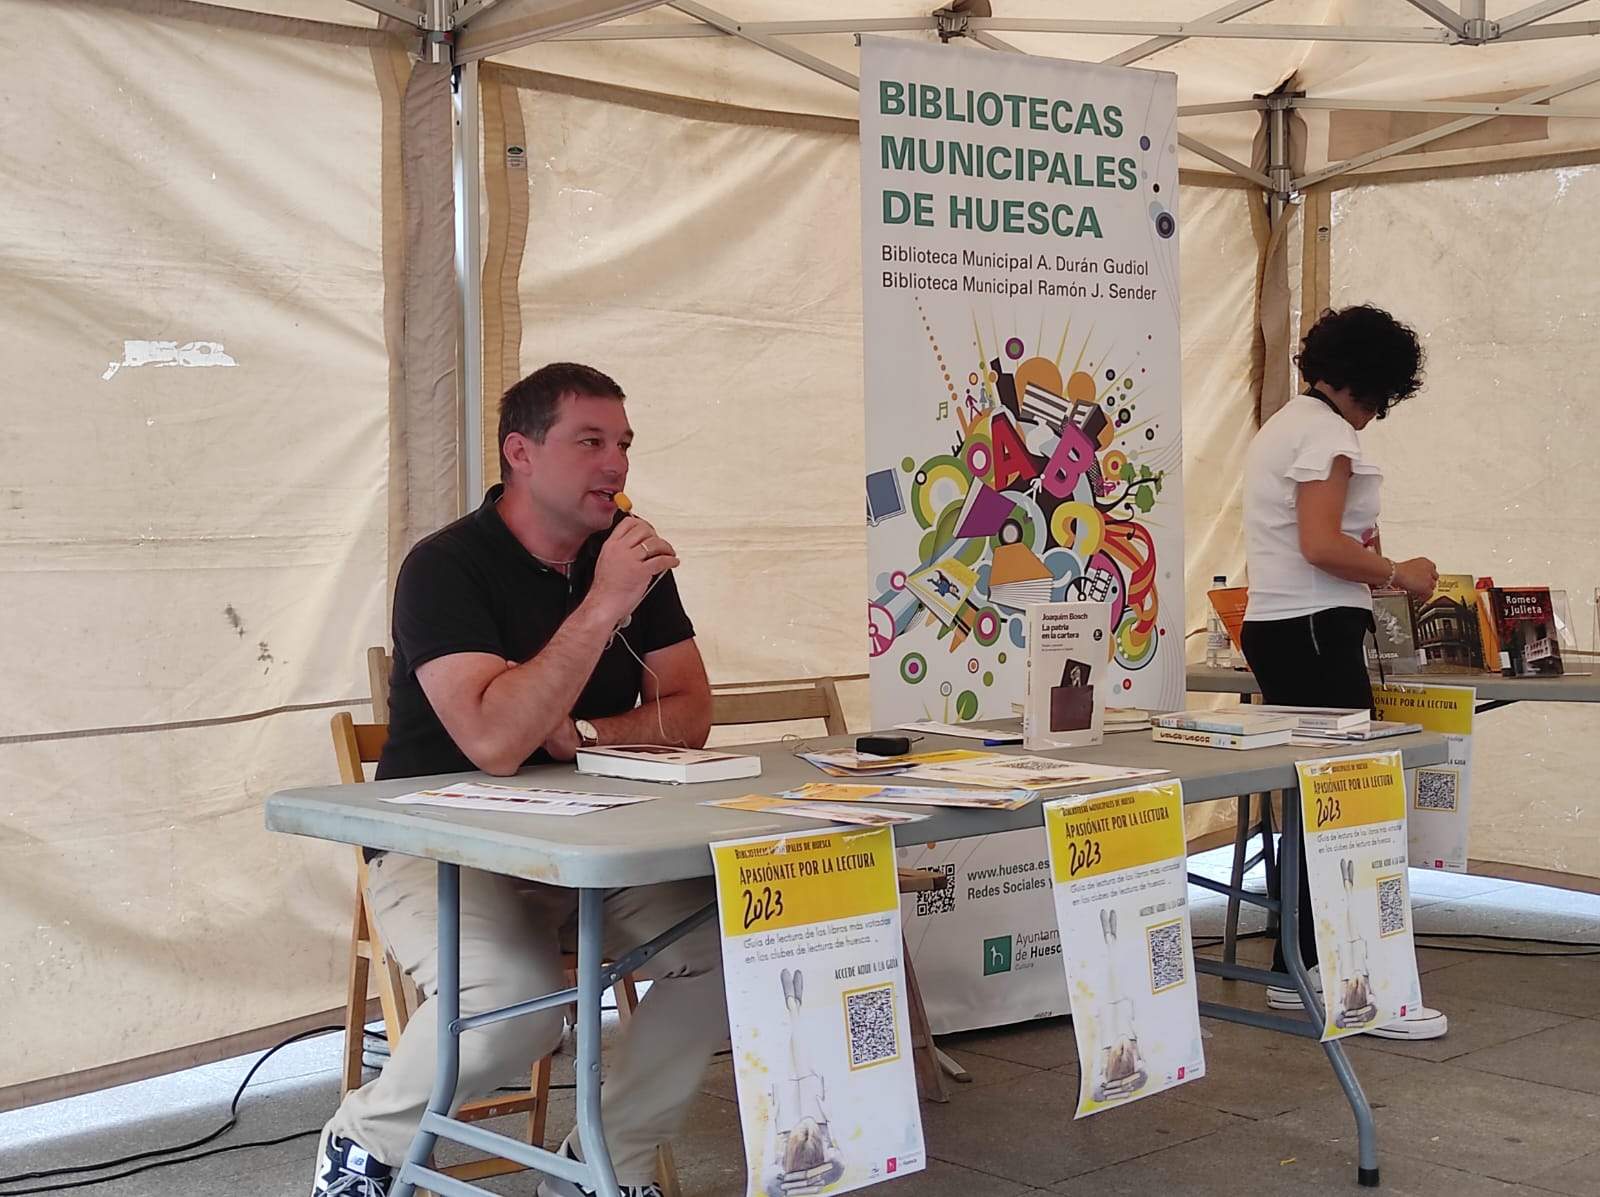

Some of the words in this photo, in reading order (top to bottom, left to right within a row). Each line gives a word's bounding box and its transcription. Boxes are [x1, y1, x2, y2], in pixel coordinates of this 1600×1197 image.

[879, 80, 1124, 139] BIBLIOTECAS
[880, 135, 1138, 191] MUNICIPALES
[881, 190, 935, 227] DE
[949, 195, 1104, 239] HUESCA
[881, 244, 958, 265] Biblioteca
[962, 250, 1033, 273] Municipal
[1036, 256, 1052, 271] A.
[1056, 256, 1098, 274] Durán
[1103, 258, 1149, 276] Gudiol
[881, 272, 958, 292] Biblioteca
[962, 277, 1033, 299] Municipal
[1037, 280, 1087, 298] Ramón
[1090, 284, 1104, 299] J.
[1108, 284, 1157, 300] Sender
[1503, 606, 1509, 616] y
[1509, 604, 1543, 617] Julieta
[1505, 595, 1537, 604] Romeo
[1050, 623, 1069, 632] patria
[1069, 612, 1088, 620] Bosch
[1427, 699, 1458, 710] LECTURA
[1065, 818, 1109, 840] APASIÓNATE
[1112, 814, 1128, 830] POR
[1130, 812, 1139, 826] LA
[1139, 806, 1170, 824] LECTURA
[1316, 796, 1341, 828] 2023
[739, 861, 797, 886] APASIÓNATE
[799, 861, 819, 878] POR
[822, 859, 834, 873] LA
[836, 852, 876, 872] LECTURA
[967, 859, 1050, 881] www.huesca.es
[1068, 839, 1101, 877] 2023
[967, 885, 1000, 900] Redes
[1002, 878, 1046, 894] Sociales
[742, 886, 784, 930] 2023
[1016, 928, 1060, 947] Ayuntam
[1015, 949, 1028, 962] de
[1030, 944, 1062, 959] Huesc
